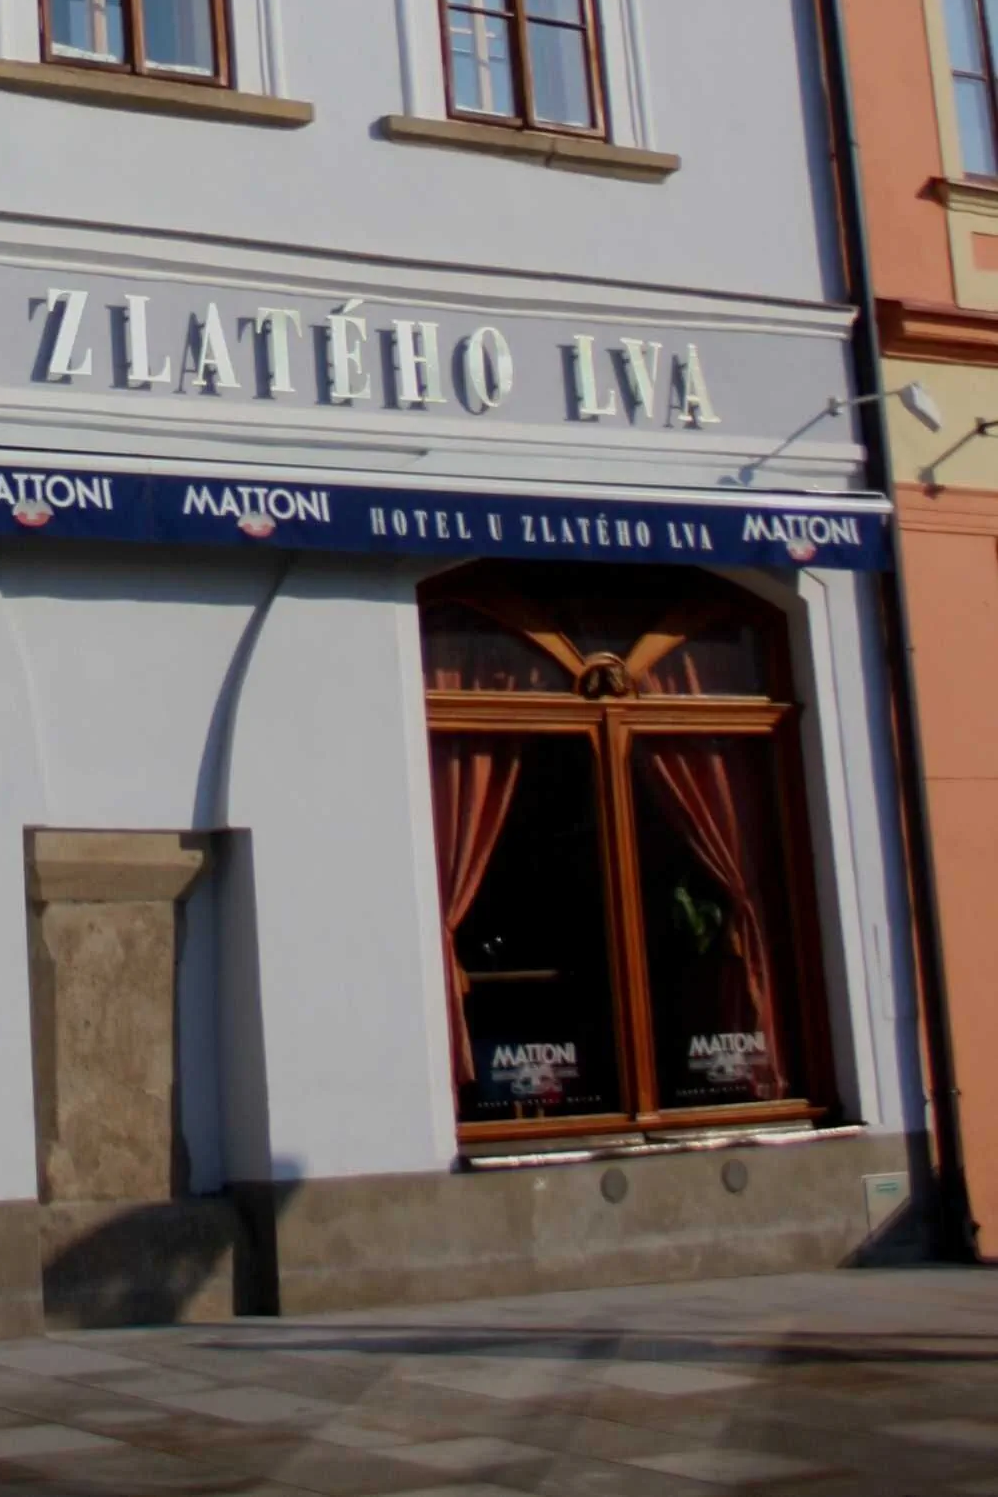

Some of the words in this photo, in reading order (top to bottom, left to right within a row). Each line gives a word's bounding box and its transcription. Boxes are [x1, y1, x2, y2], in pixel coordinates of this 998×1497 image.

[45, 288, 514, 408] ZLATÉHO
[572, 333, 722, 424] LVA
[182, 484, 331, 524] MATTONI
[370, 506, 472, 541] HOTEL
[487, 513, 503, 542] U
[520, 514, 651, 548] ZLATÉHO
[667, 522, 713, 551] LVA
[742, 512, 861, 546] MATTONI
[492, 1041, 577, 1068] MATTONI
[689, 1031, 766, 1056] MATTONI
